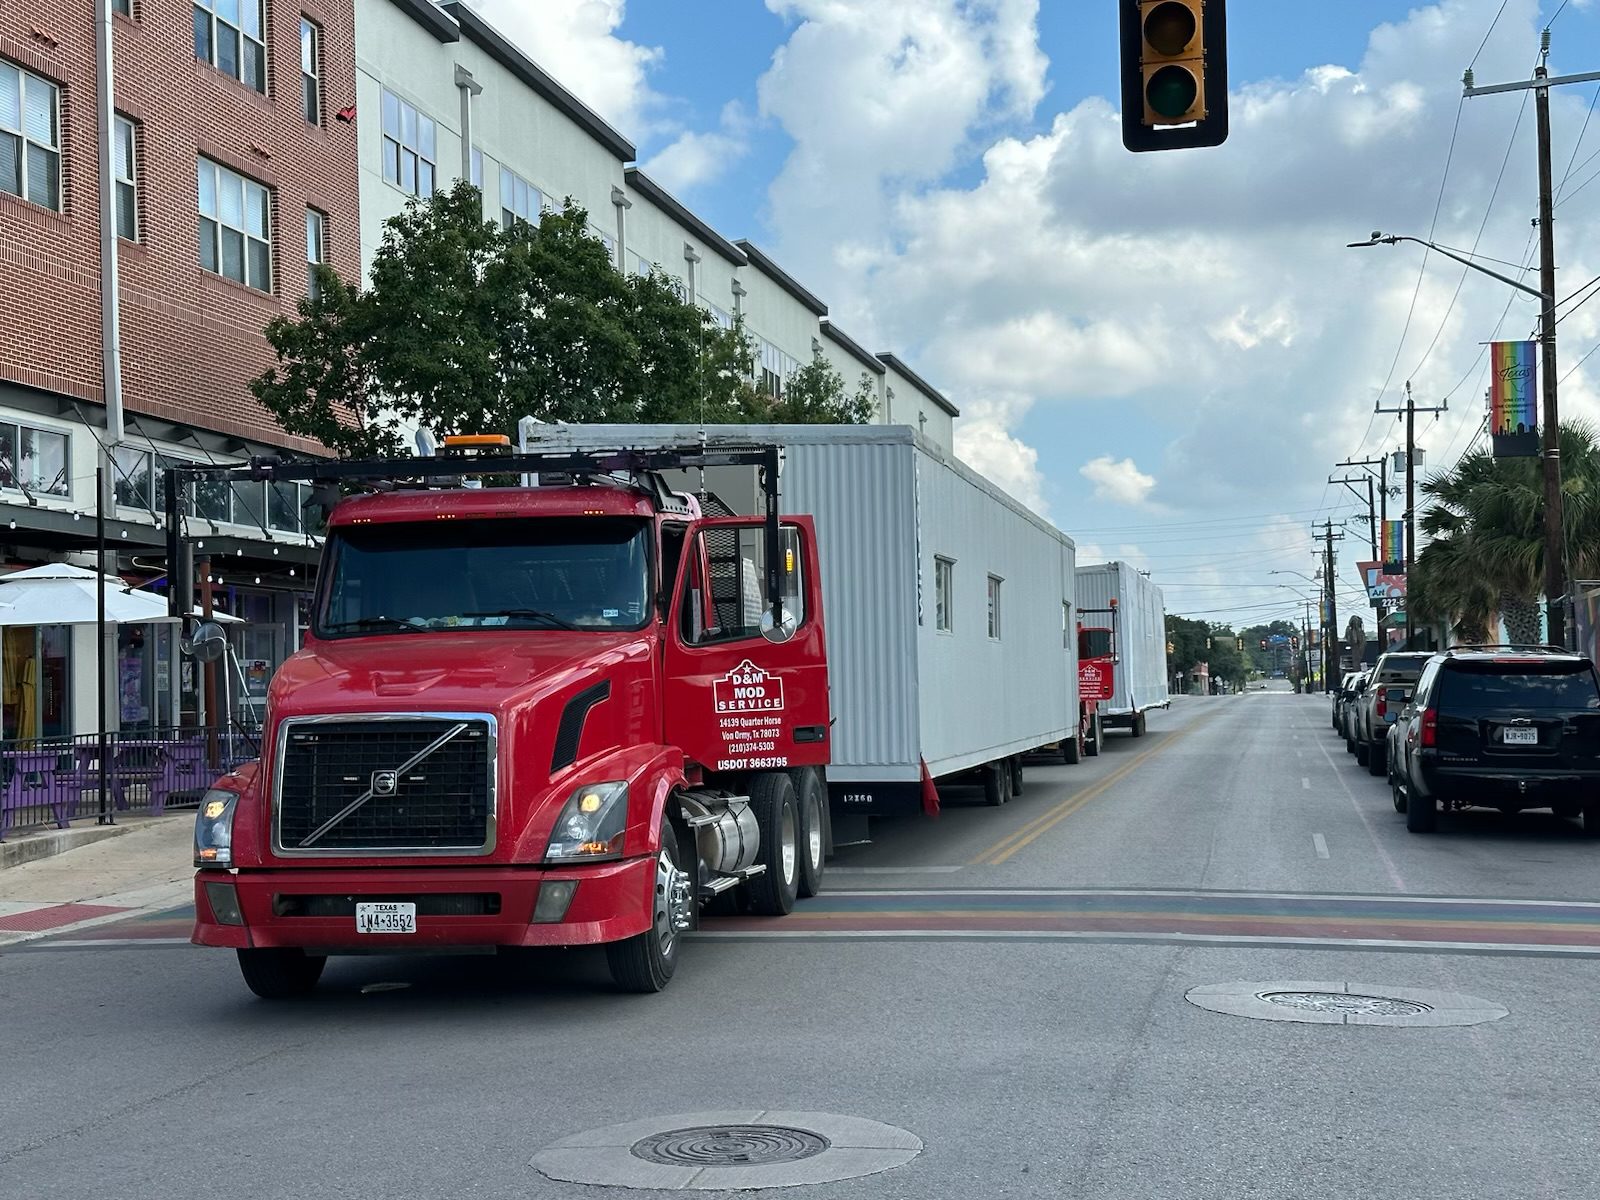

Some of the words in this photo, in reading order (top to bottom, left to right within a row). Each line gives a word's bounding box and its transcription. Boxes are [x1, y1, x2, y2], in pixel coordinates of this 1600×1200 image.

[1499, 361, 1531, 382] Texas
[732, 672, 764, 685] D&M
[734, 686, 765, 699] MOD
[718, 698, 781, 710] SERVICE
[719, 718, 739, 727] 14139
[740, 717, 763, 728] Quarter
[764, 716, 782, 726] Horse
[721, 731, 734, 741] Von
[752, 730, 760, 739] Tx
[760, 728, 780, 738] 78073
[728, 741, 775, 755] (210)374-5303
[717, 758, 748, 771] USDOT
[749, 756, 788, 769] 3663795
